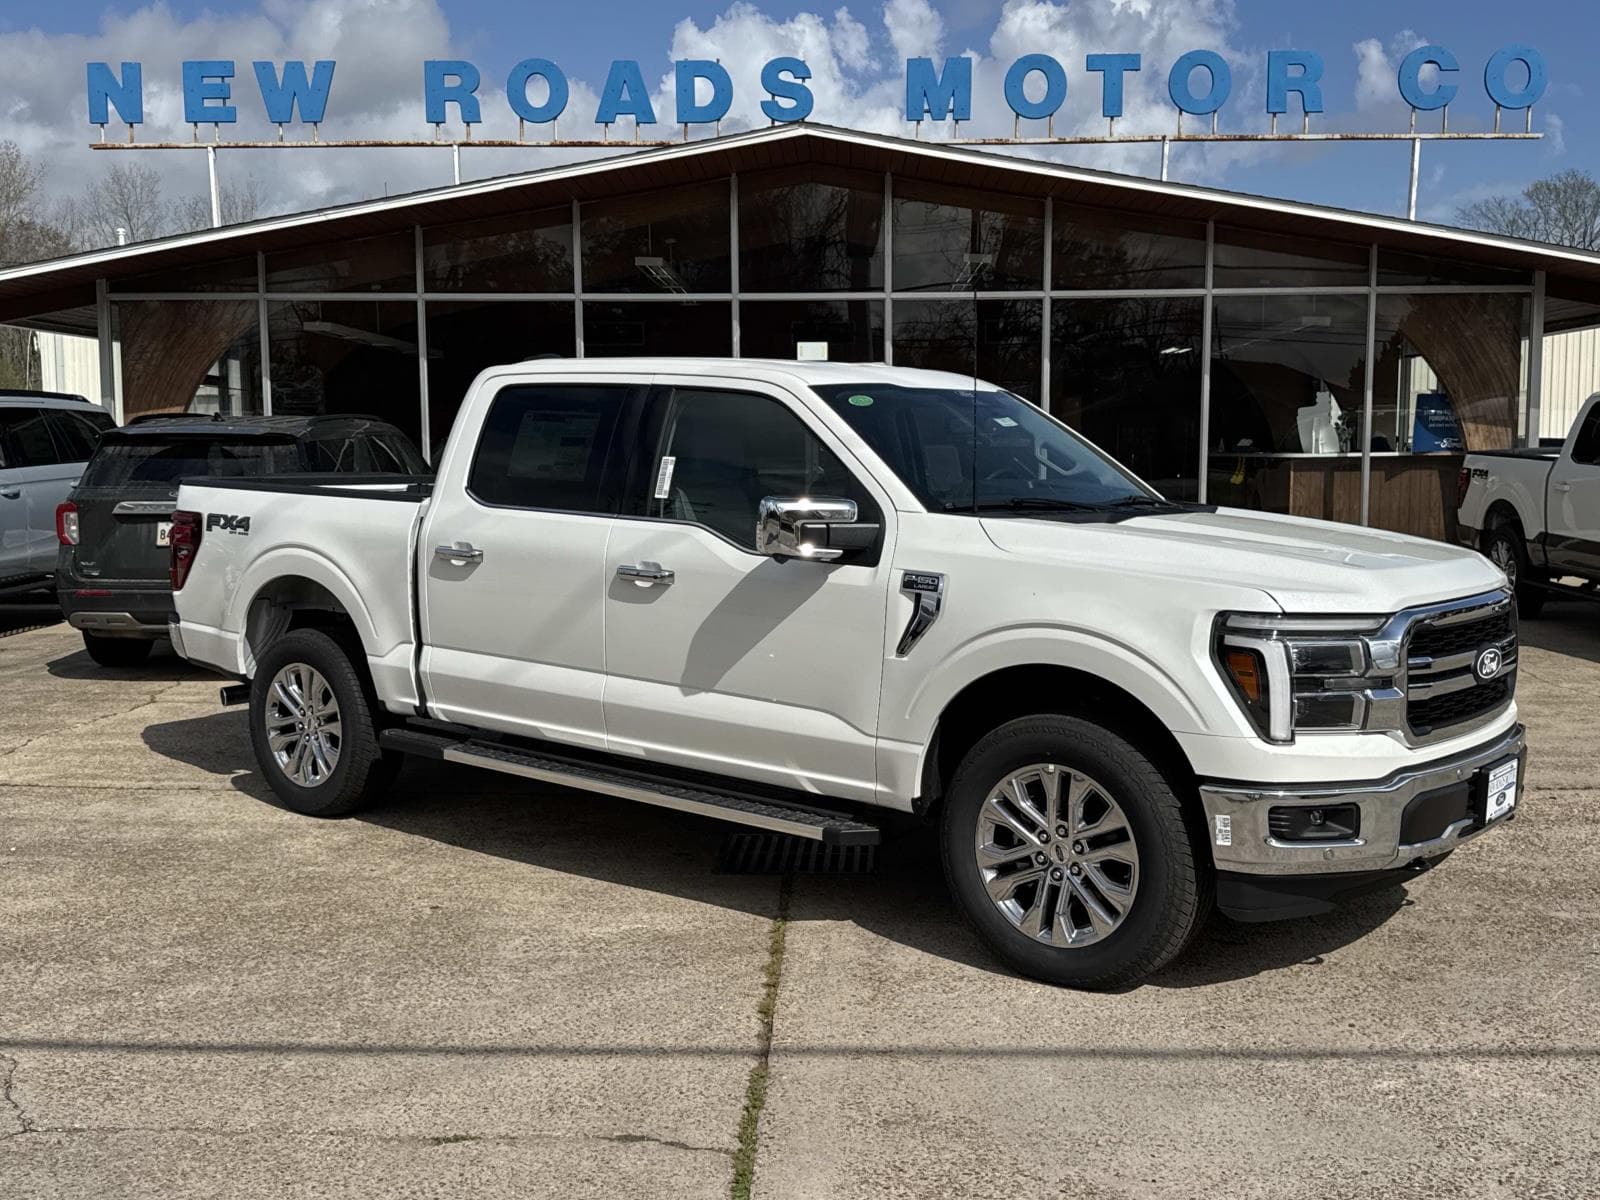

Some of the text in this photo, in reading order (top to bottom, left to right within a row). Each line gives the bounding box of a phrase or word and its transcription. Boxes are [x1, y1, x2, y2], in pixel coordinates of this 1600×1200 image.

[87, 45, 1549, 125] NEW ROADS MOTOR CO
[206, 513, 250, 532] FX4
[904, 574, 938, 585] F-150
